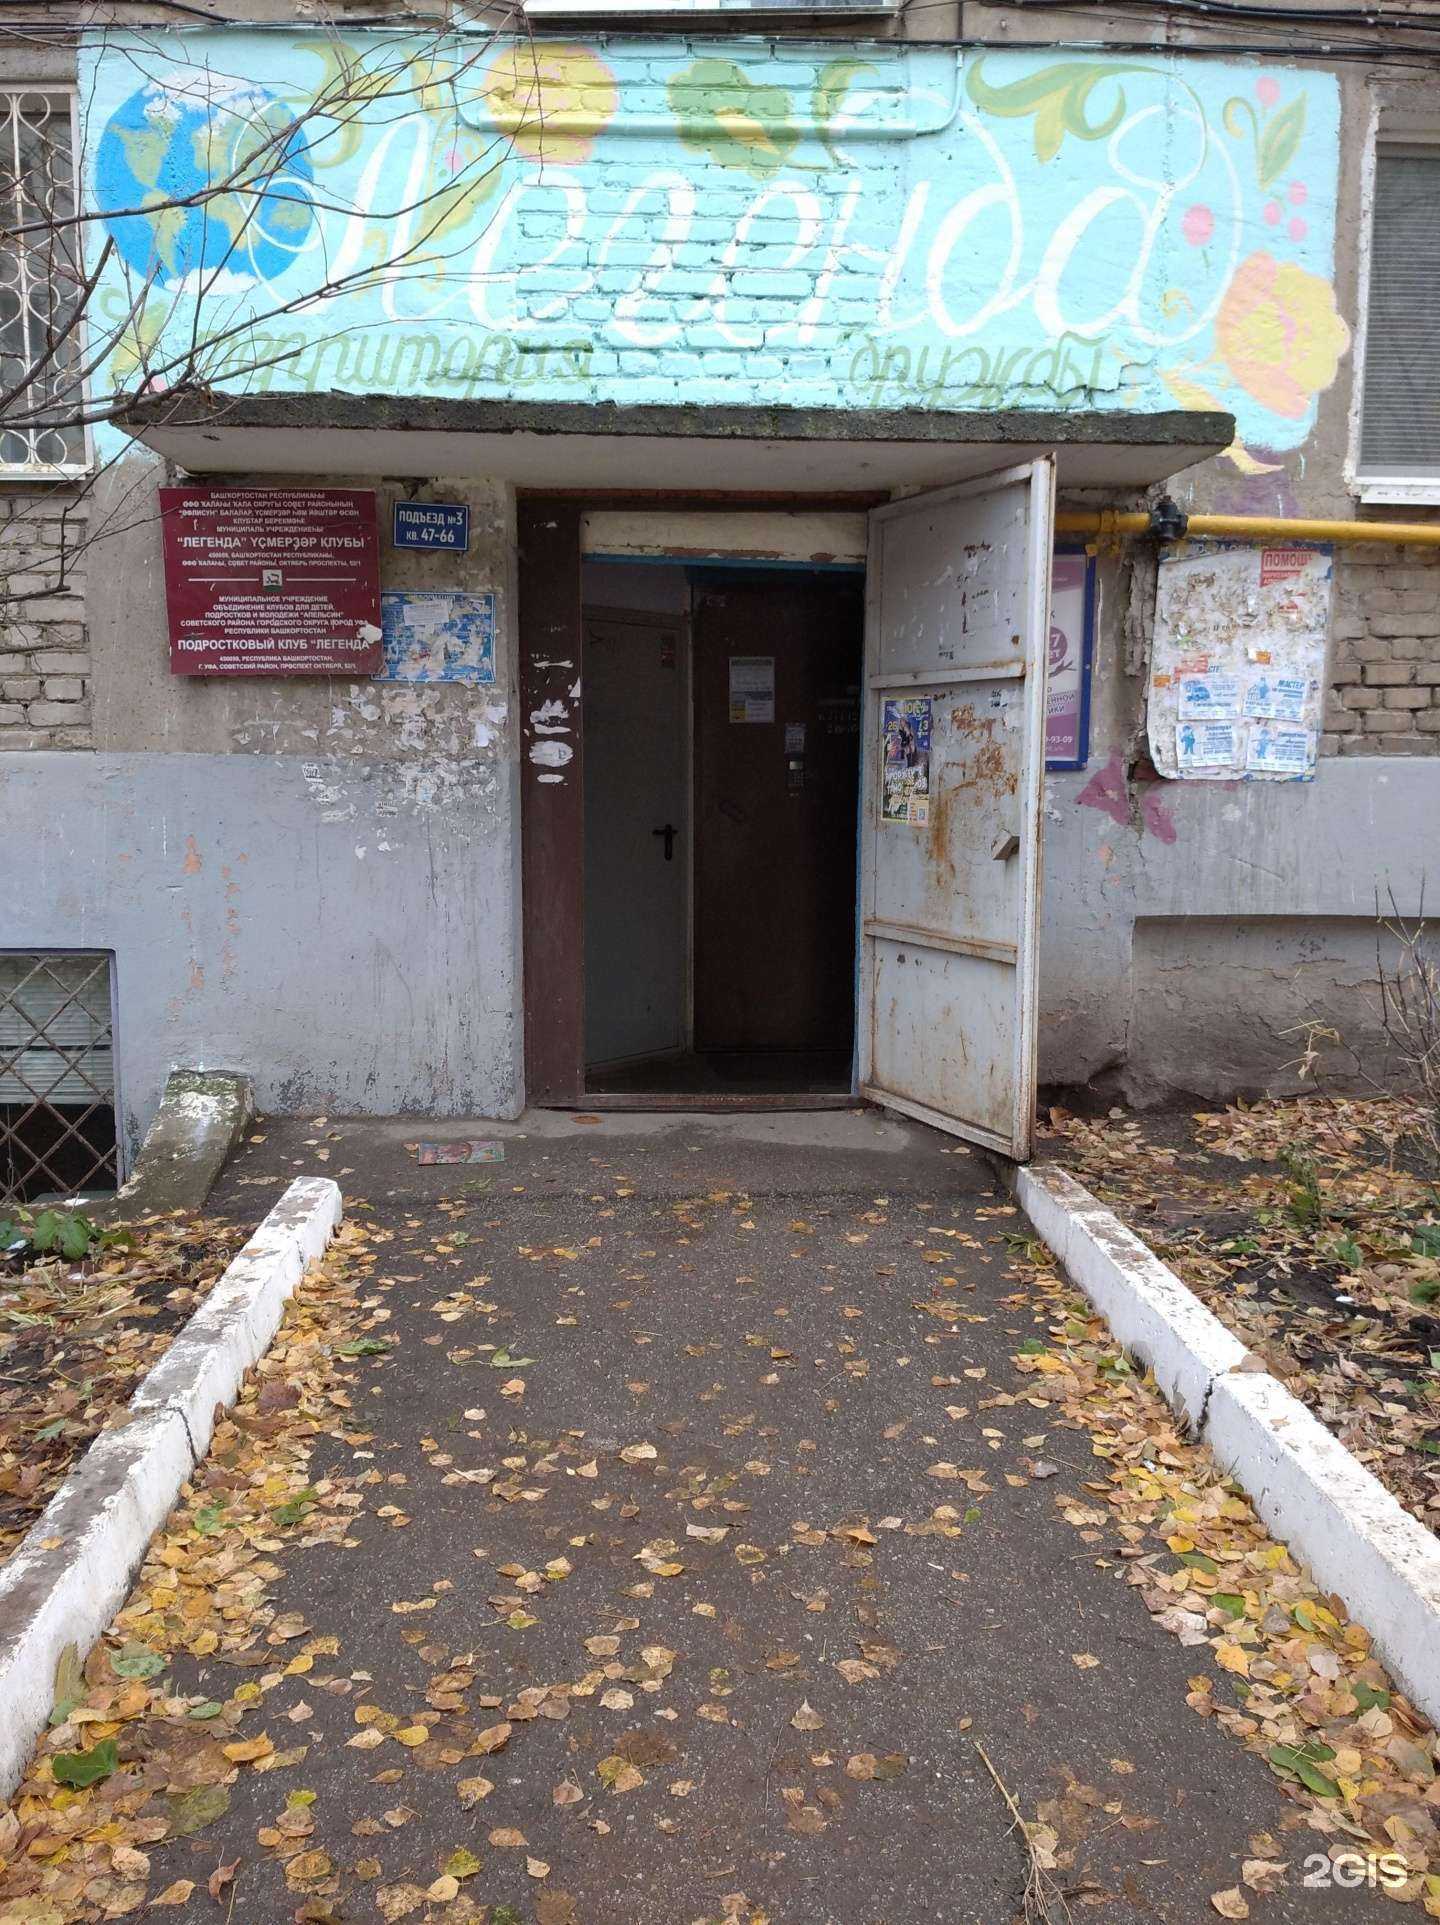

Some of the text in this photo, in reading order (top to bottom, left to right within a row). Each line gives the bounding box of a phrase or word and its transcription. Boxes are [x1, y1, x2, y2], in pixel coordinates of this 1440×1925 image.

[399, 510, 445, 526] ПОДЪЕЗД
[177, 536, 247, 549] "ЛЕГЕНДА"
[320, 537, 365, 548] КЛУБЫ
[421, 528, 455, 543] 47-66
[177, 637, 275, 651] ПОДРОСТКОВЫЙ
[278, 639, 308, 650] КЛУБ
